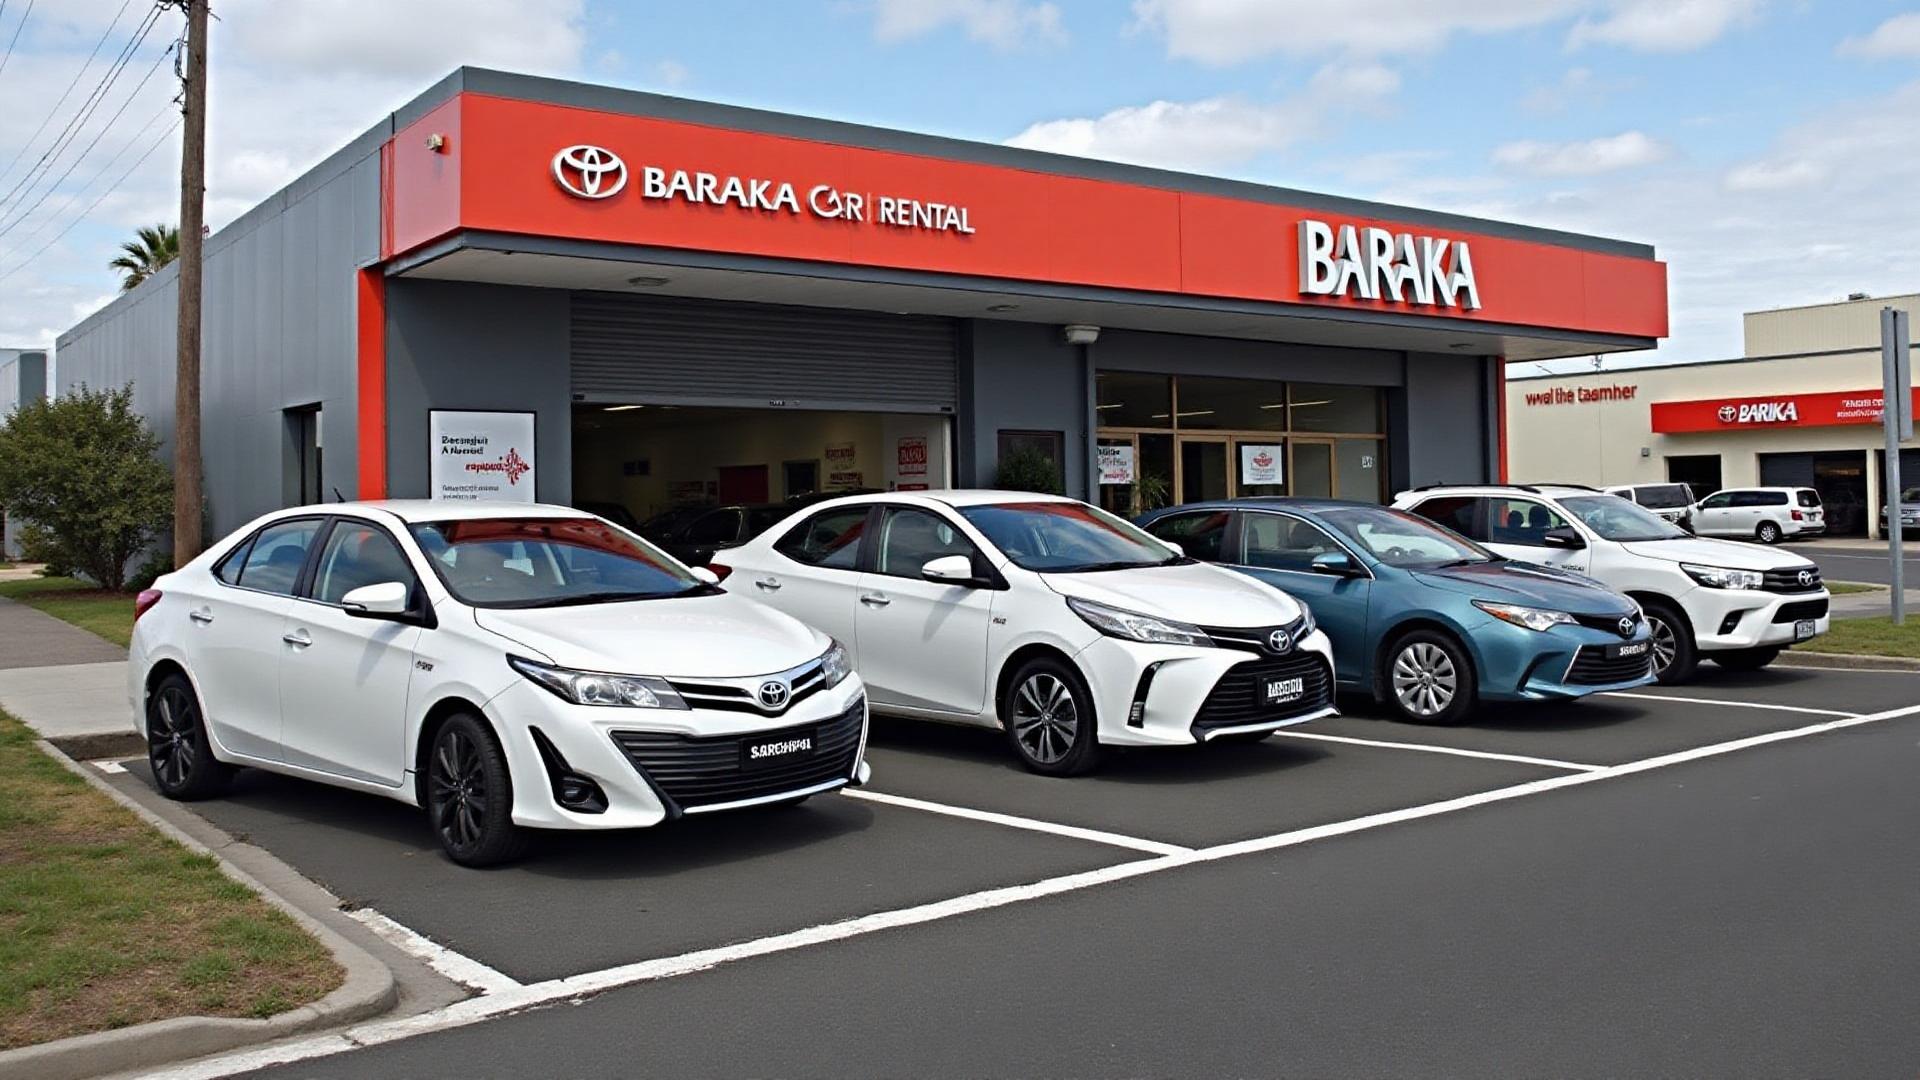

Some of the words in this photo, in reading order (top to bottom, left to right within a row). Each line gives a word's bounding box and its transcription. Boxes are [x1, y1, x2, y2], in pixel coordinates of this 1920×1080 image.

[643, 166, 800, 214] BARAKA
[879, 196, 976, 235] RENTAL
[1298, 219, 1482, 310] BARAKA
[1737, 402, 1798, 423] BARIKA
